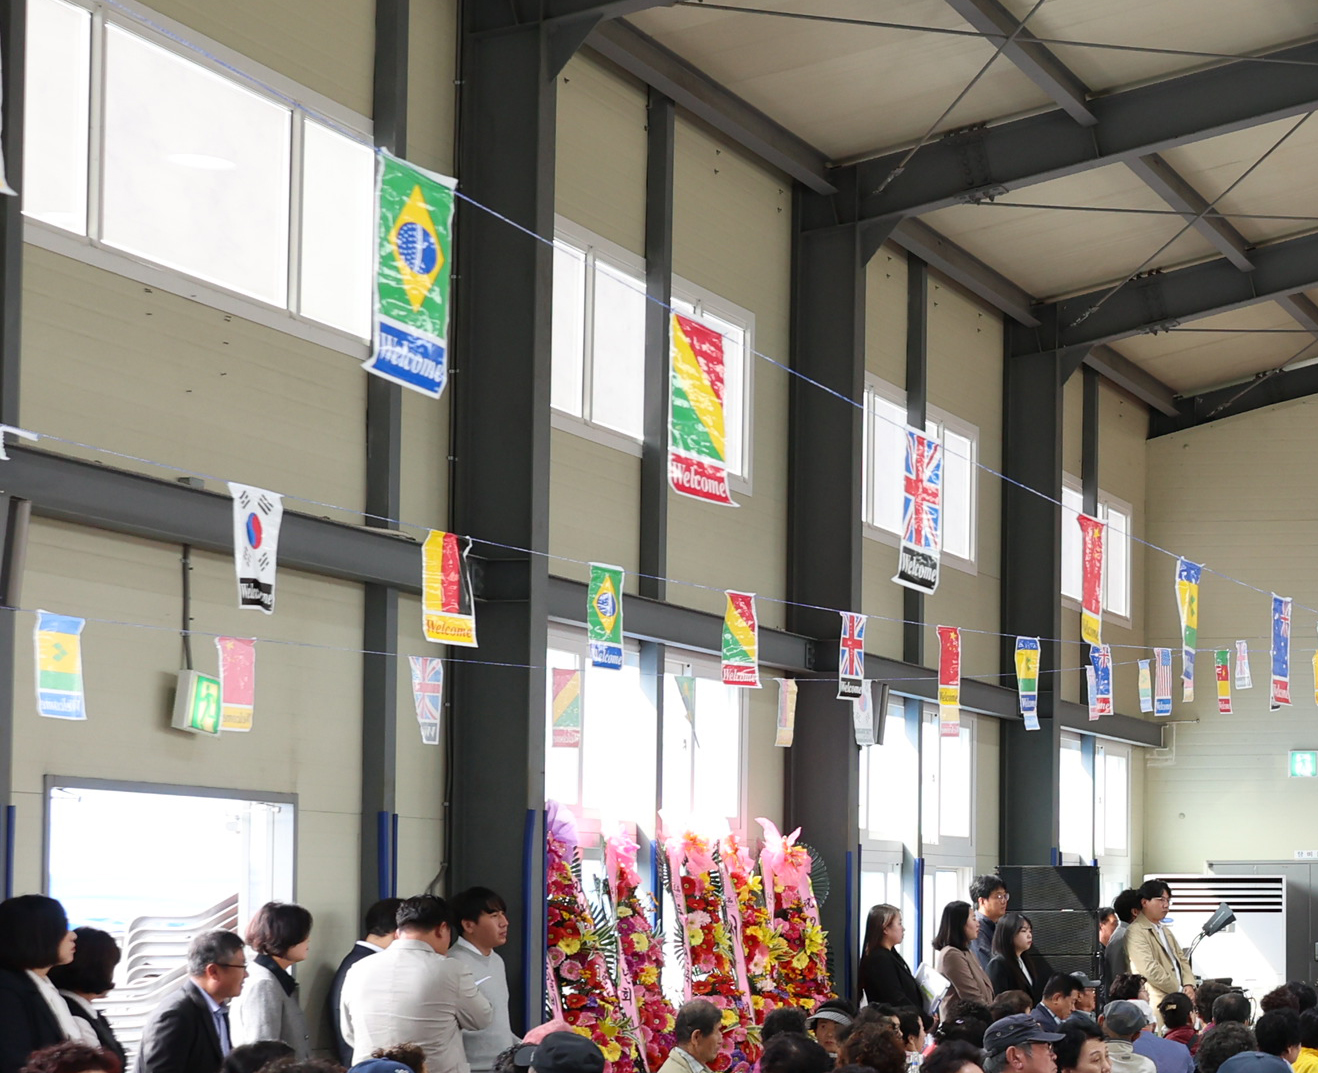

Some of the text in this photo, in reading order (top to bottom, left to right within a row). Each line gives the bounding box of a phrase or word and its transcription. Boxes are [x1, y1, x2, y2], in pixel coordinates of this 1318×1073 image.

[380, 335, 444, 381] Welcome
[671, 462, 727, 496] Welcome
[901, 553, 937, 582] Welcome
[426, 618, 473, 640] Welcome
[591, 647, 622, 665] Welcome
[722, 667, 756, 683] Welcome
[839, 681, 862, 694] Welcome
